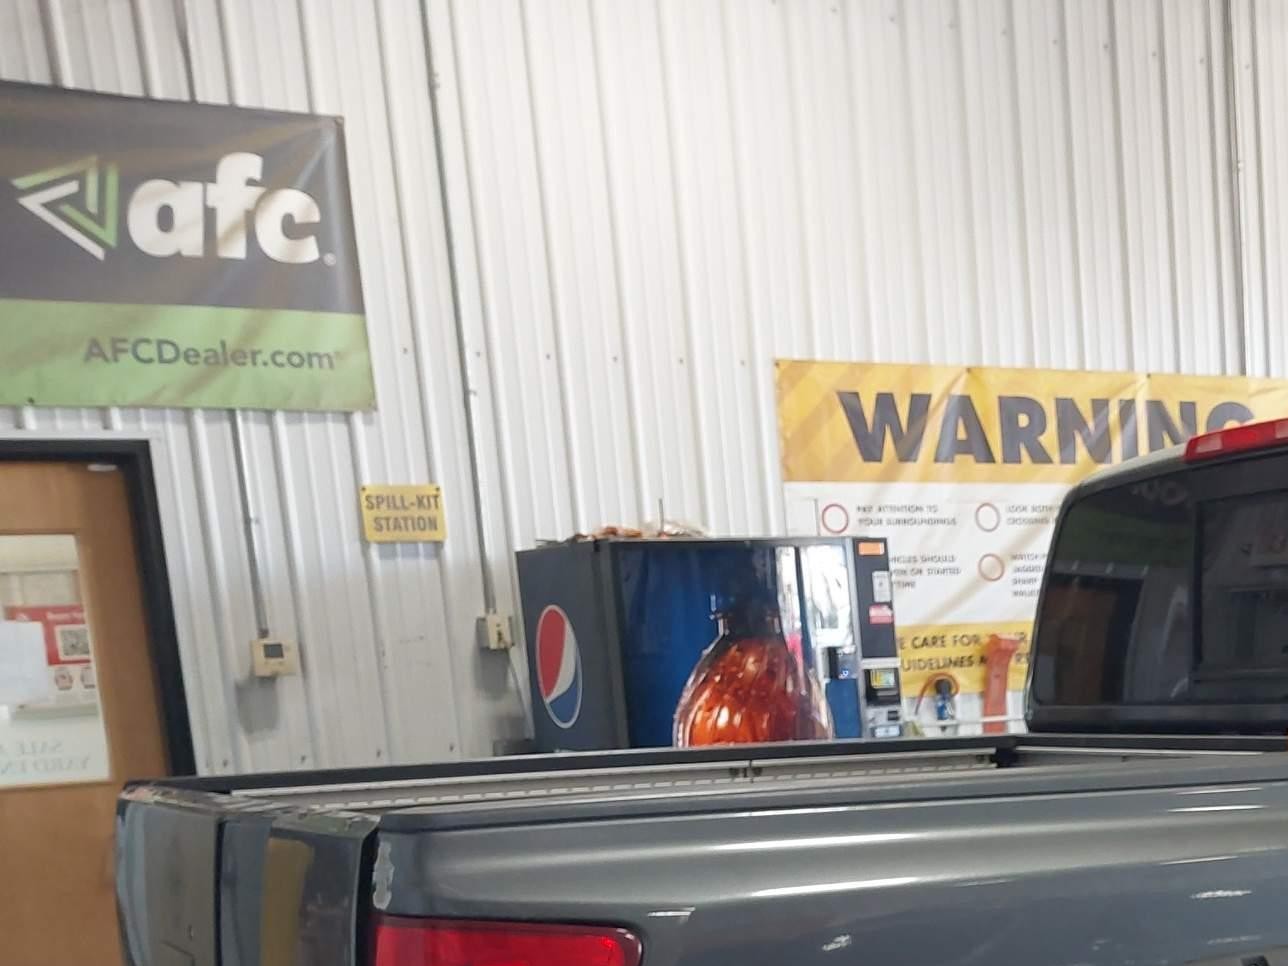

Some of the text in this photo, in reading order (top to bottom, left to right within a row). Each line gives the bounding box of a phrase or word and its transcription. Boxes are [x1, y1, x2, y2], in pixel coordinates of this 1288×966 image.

[127, 152, 321, 263] afc
[83, 338, 335, 370] AFCDealer.com
[365, 495, 440, 511] SPILL-KIT
[374, 516, 438, 532] STATION
[911, 635, 946, 649] CARE
[951, 634, 983, 647] FOR
[902, 655, 979, 672] UIDELINES
